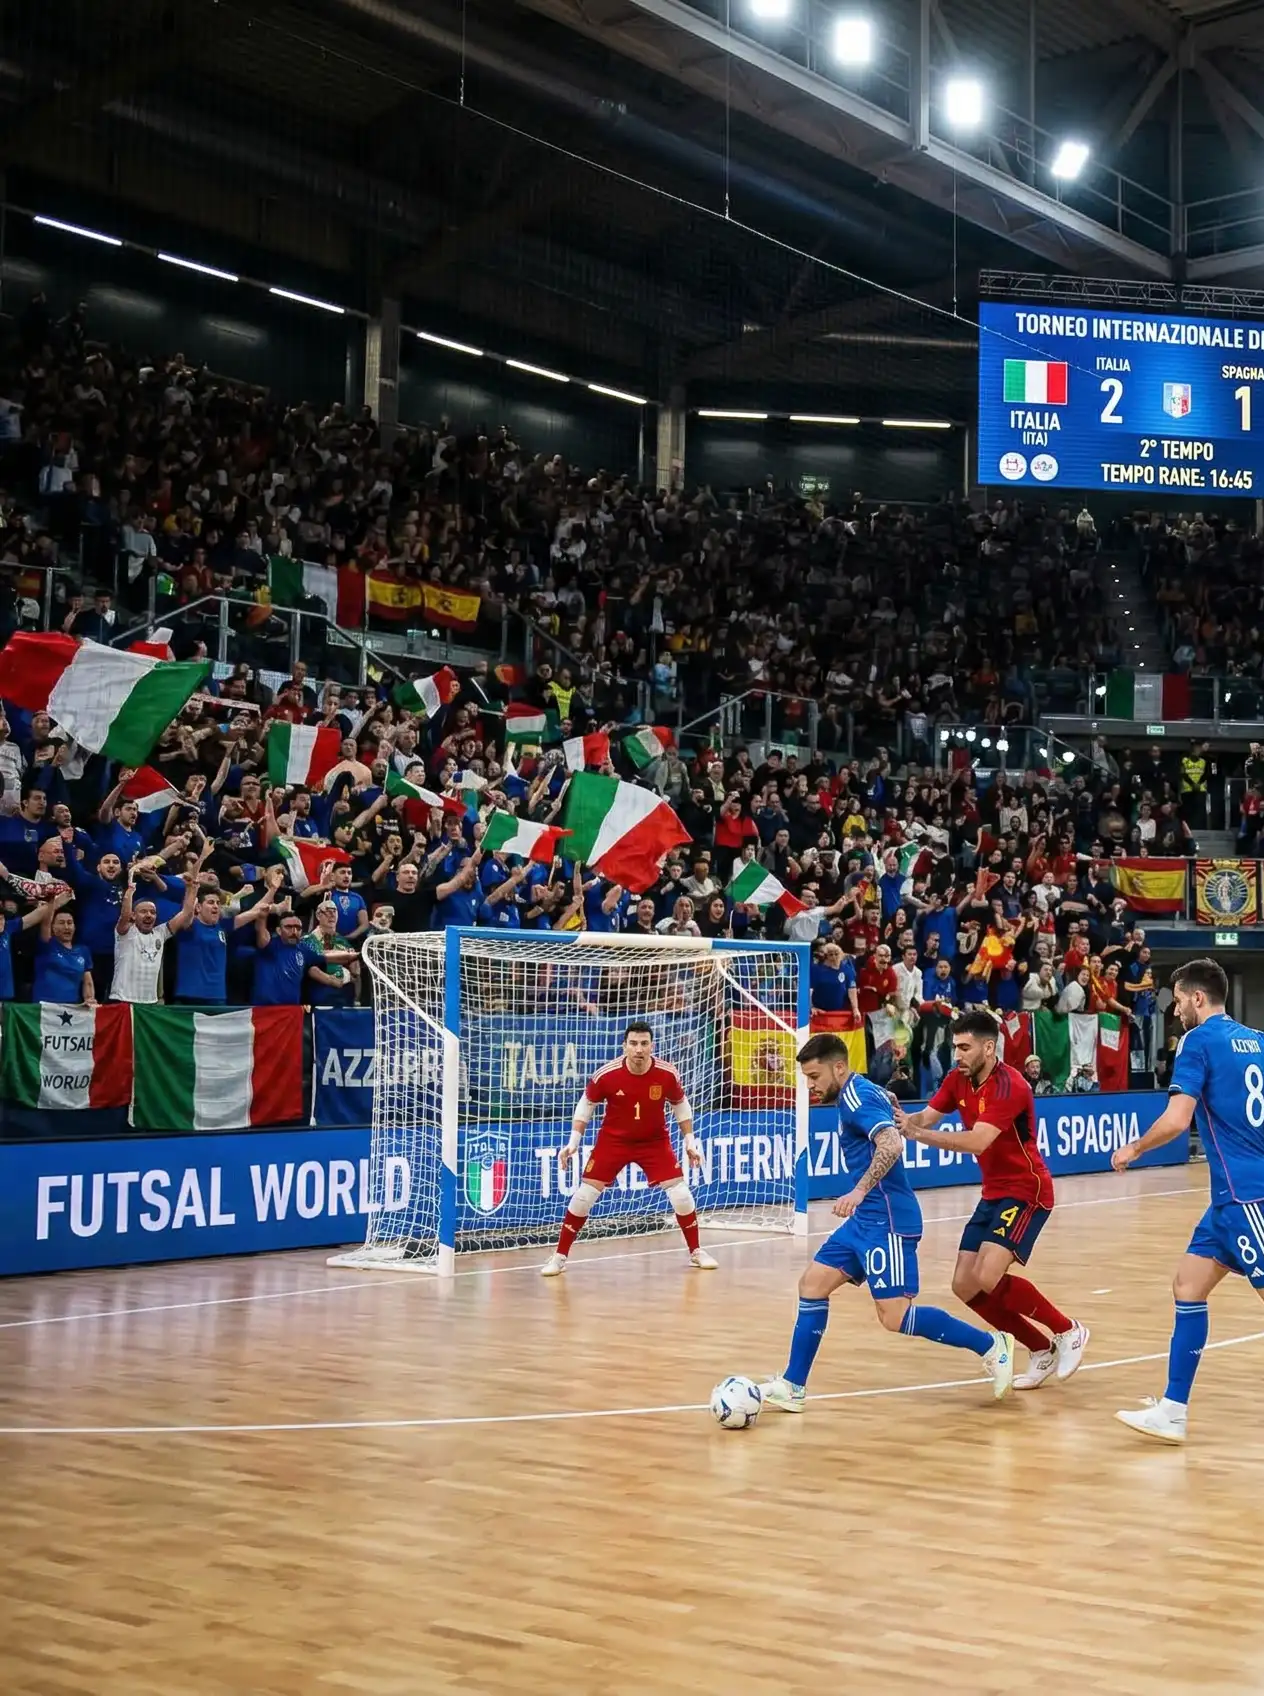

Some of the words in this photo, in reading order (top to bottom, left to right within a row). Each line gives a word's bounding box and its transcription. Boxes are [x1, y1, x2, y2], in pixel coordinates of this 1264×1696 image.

[1015, 312, 1088, 339] TORNEO
[1093, 318, 1244, 349] INTERNAZIONALE
[1096, 356, 1131, 372] ITALIA
[1100, 378, 1123, 424] 2
[1235, 385, 1251, 431] 1
[1010, 410, 1061, 431] ITALIA
[1140, 439, 1158, 458] 2°
[1161, 440, 1214, 462] TEMPO
[1101, 463, 1154, 485] TEMPO
[1159, 466, 1206, 488] RANE:
[1210, 468, 1253, 490] 16:45
[44, 1035, 93, 1052] FUTSAL
[42, 1074, 91, 1090] WORLD
[634, 1102, 641, 1120] 1
[1057, 1112, 1140, 1156] SPAGNA
[36, 1166, 236, 1241] FUTSAL
[249, 1156, 411, 1222] WORLD
[1000, 1205, 1019, 1227] 4
[865, 1246, 887, 1276] 10
[1236, 1234, 1257, 1265] 8
